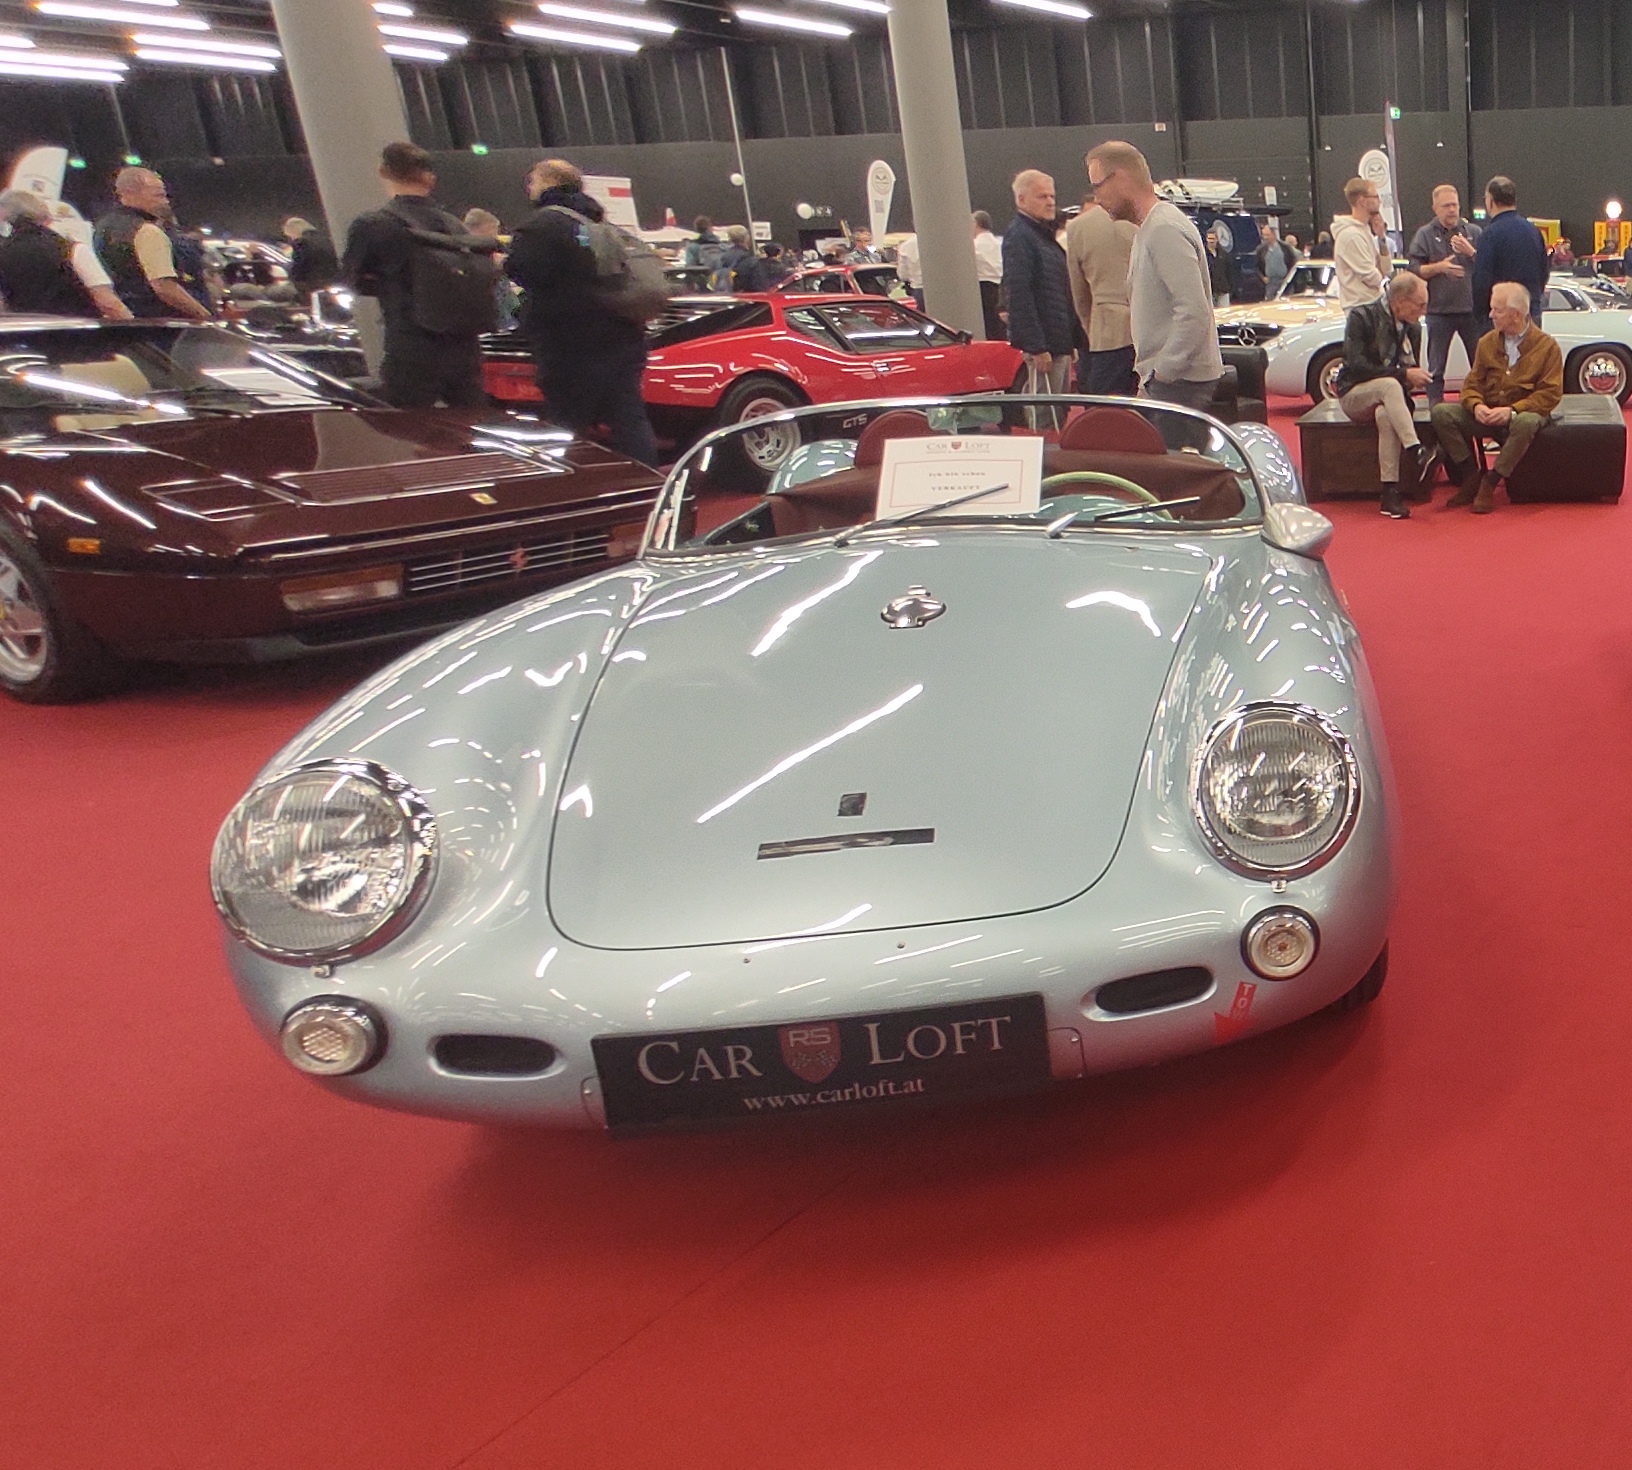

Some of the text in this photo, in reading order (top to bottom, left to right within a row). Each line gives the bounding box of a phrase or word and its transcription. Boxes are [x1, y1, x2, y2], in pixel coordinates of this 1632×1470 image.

[842, 413, 867, 429] GTS
[926, 441, 991, 450] CAR LOFT
[637, 1016, 1012, 1086] CAR RS LOFT
[743, 1076, 925, 1112] www.carloft.at
